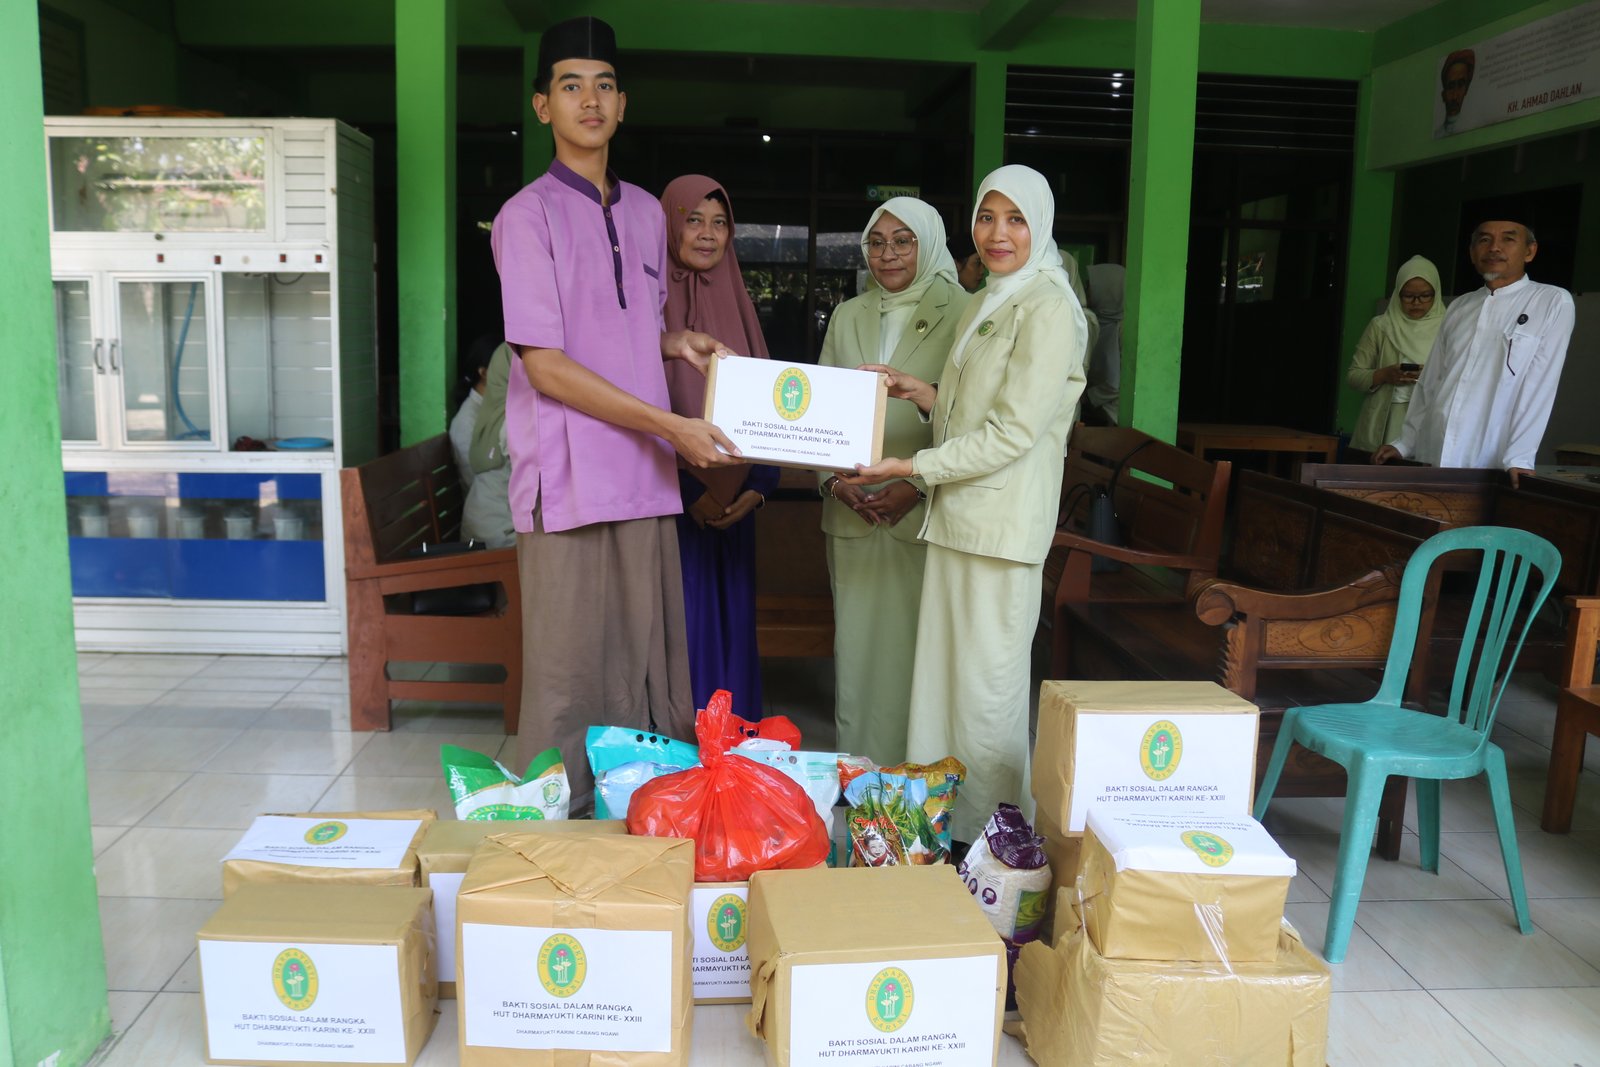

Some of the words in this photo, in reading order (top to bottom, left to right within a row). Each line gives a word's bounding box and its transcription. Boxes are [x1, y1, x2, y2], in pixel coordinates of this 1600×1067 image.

[1507, 101, 1519, 113] KH.
[1521, 92, 1548, 110] AHMAD
[1550, 82, 1583, 102] DAHLAN
[749, 430, 797, 440] DHARMAYUKTI
[764, 422, 788, 431] SOSIAL
[790, 425, 814, 433] DALAM
[815, 427, 843, 436] RANGKA
[512, 1012, 574, 1020] DHARMAYUKTI
[890, 1036, 919, 1045] DALAM
[922, 1033, 957, 1042] RANGKA
[838, 1048, 900, 1057] DHARMAYUKTI
[902, 1045, 930, 1053] KARINI
